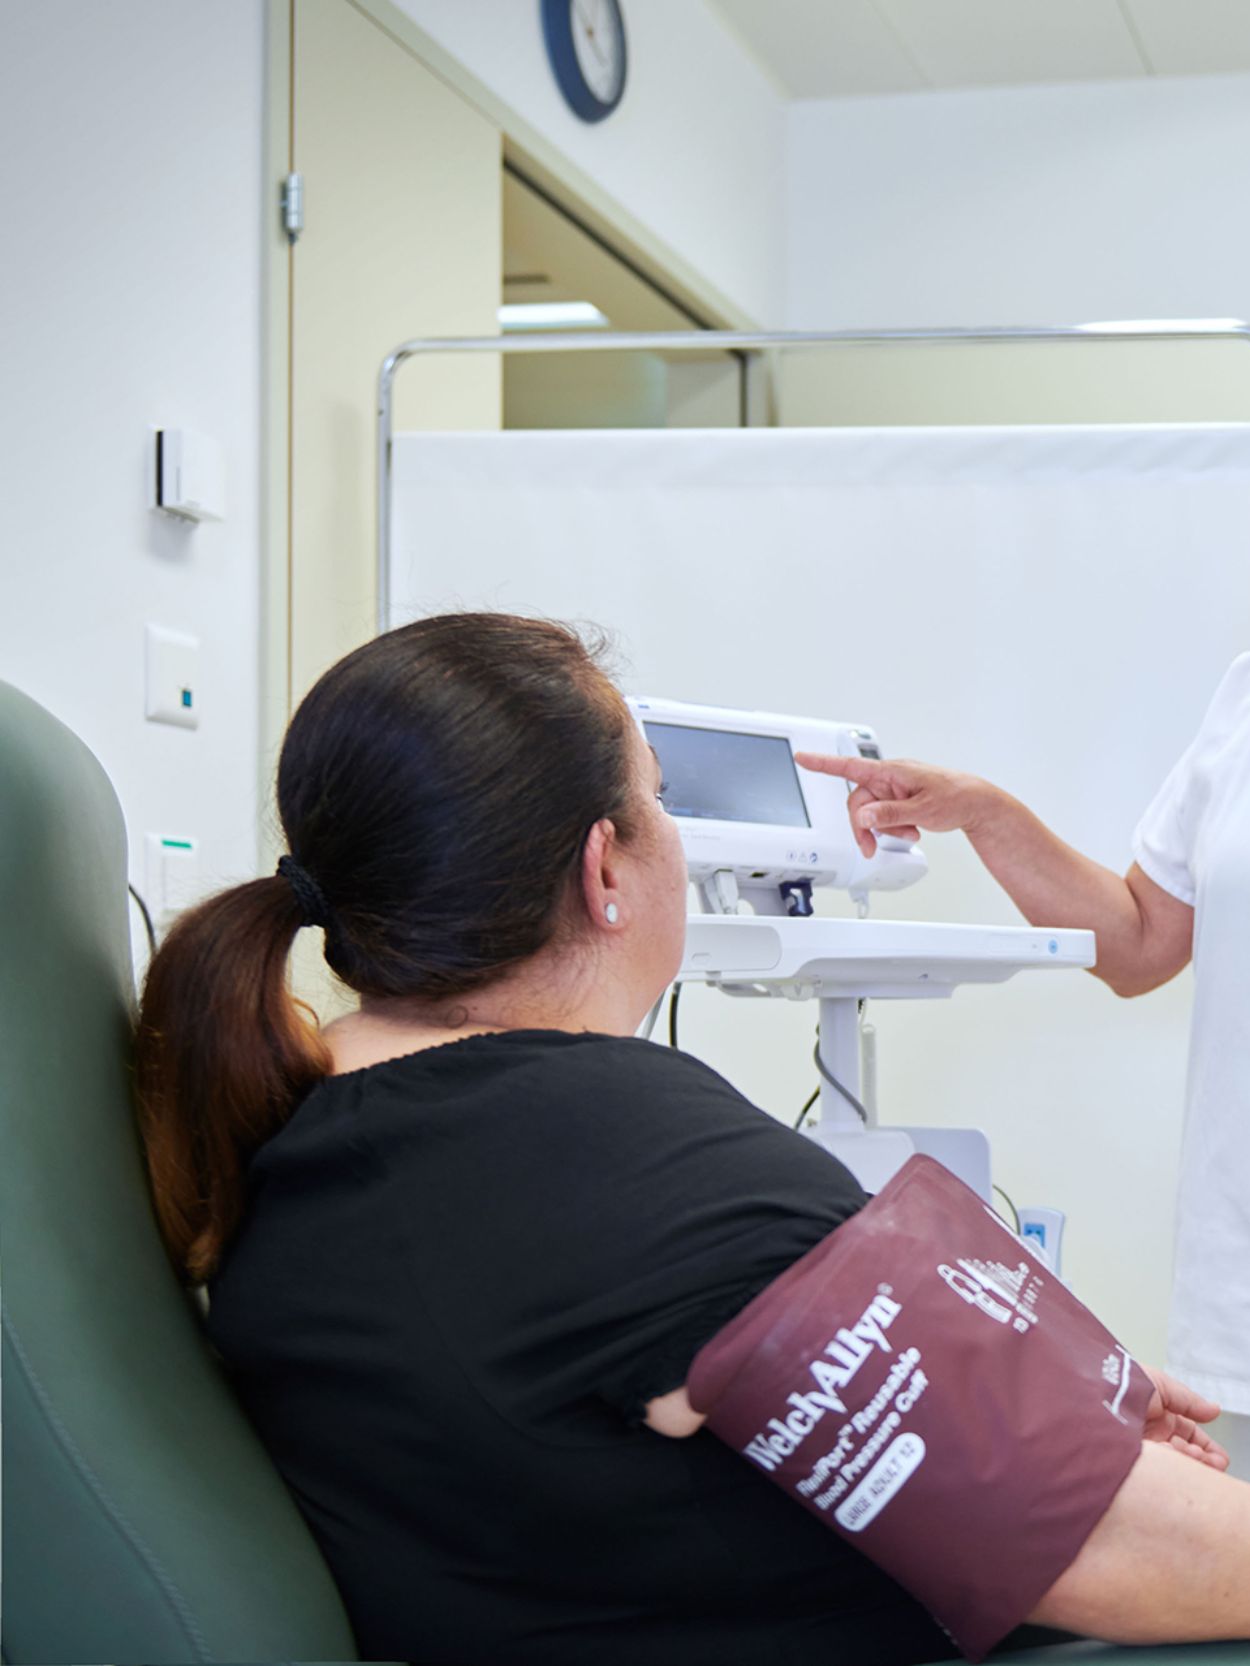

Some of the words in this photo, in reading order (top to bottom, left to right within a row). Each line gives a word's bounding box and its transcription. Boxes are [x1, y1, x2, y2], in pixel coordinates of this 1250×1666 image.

[852, 1347, 922, 1433] Reusable
[814, 1477, 848, 1509] Blood
[842, 1411, 901, 1480] Pressure
[895, 1369, 928, 1412] Cuff
[848, 1496, 872, 1526] LARGE
[871, 1458, 899, 1497] ADULT
